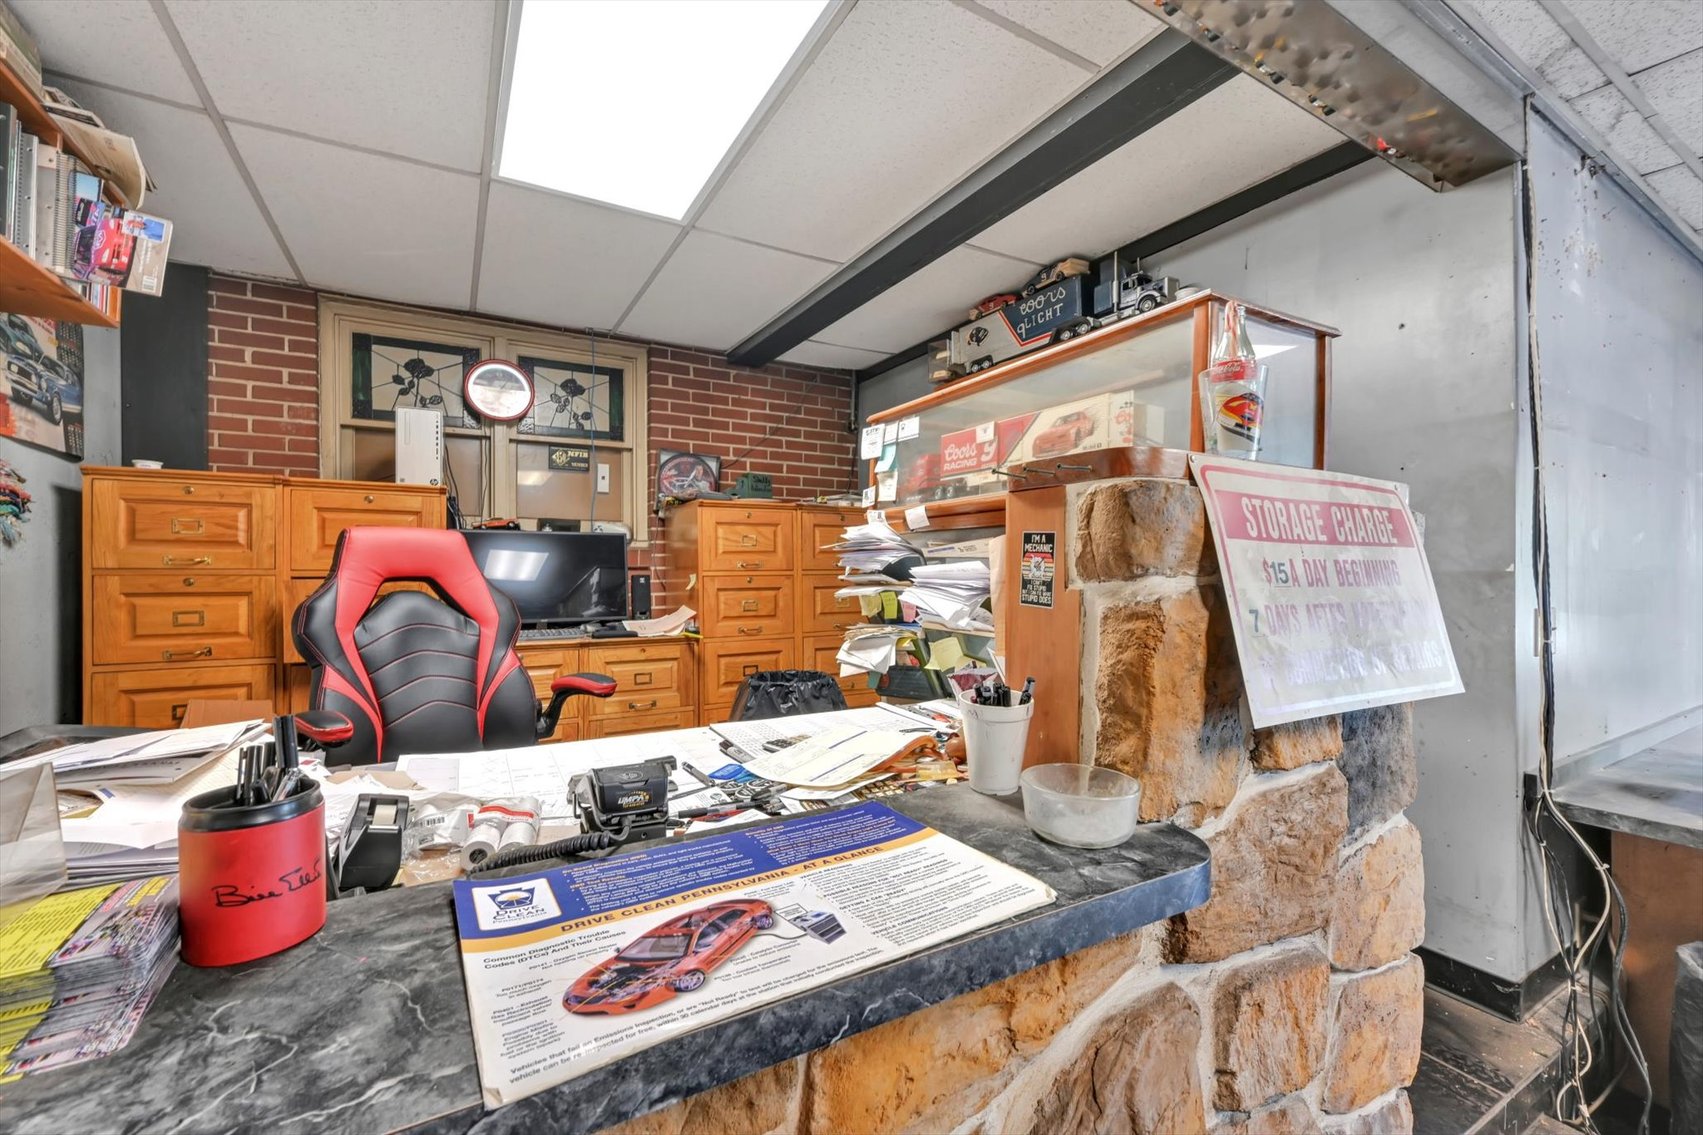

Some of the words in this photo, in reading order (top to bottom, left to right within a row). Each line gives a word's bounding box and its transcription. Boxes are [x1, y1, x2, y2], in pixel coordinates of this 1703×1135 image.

[944, 443, 977, 462] Coors
[944, 458, 977, 471] RACING
[1241, 496, 1328, 542] STORAGE
[1331, 506, 1398, 544] CHARGE
[1024, 543, 1053, 553] MECHANIC
[1041, 534, 1046, 543] A
[1302, 557, 1331, 588] DAY
[1335, 557, 1401, 588] BEGINNING
[1038, 595, 1051, 604] DOES
[1248, 608, 1260, 634] 7
[1264, 604, 1302, 636] DAYS
[560, 913, 616, 933] DRIVE
[621, 898, 677, 917] CLEAN
[681, 870, 789, 902] PENNSYLVANIA
[802, 860, 820, 872] AT
[822, 854, 832, 867] A
[833, 845, 884, 864] GLANCE
[492, 906, 546, 921] CLEAN
[495, 903, 541, 919] DRIVE
[483, 952, 526, 966] Common
[528, 939, 575, 954] Diagnostic
[578, 930, 609, 939] Trouble
[484, 957, 515, 969] Codes
[551, 945, 568, 953] And
[571, 939, 592, 947] Their
[595, 931, 625, 941] Causes
[510, 1058, 547, 1073] Vehicles
[549, 1049, 565, 1059] that
[594, 1026, 633, 1042] Emissions
[634, 1012, 675, 1027] Inspection,
[510, 1068, 540, 1083] vehicle
[543, 1061, 558, 1070] can
